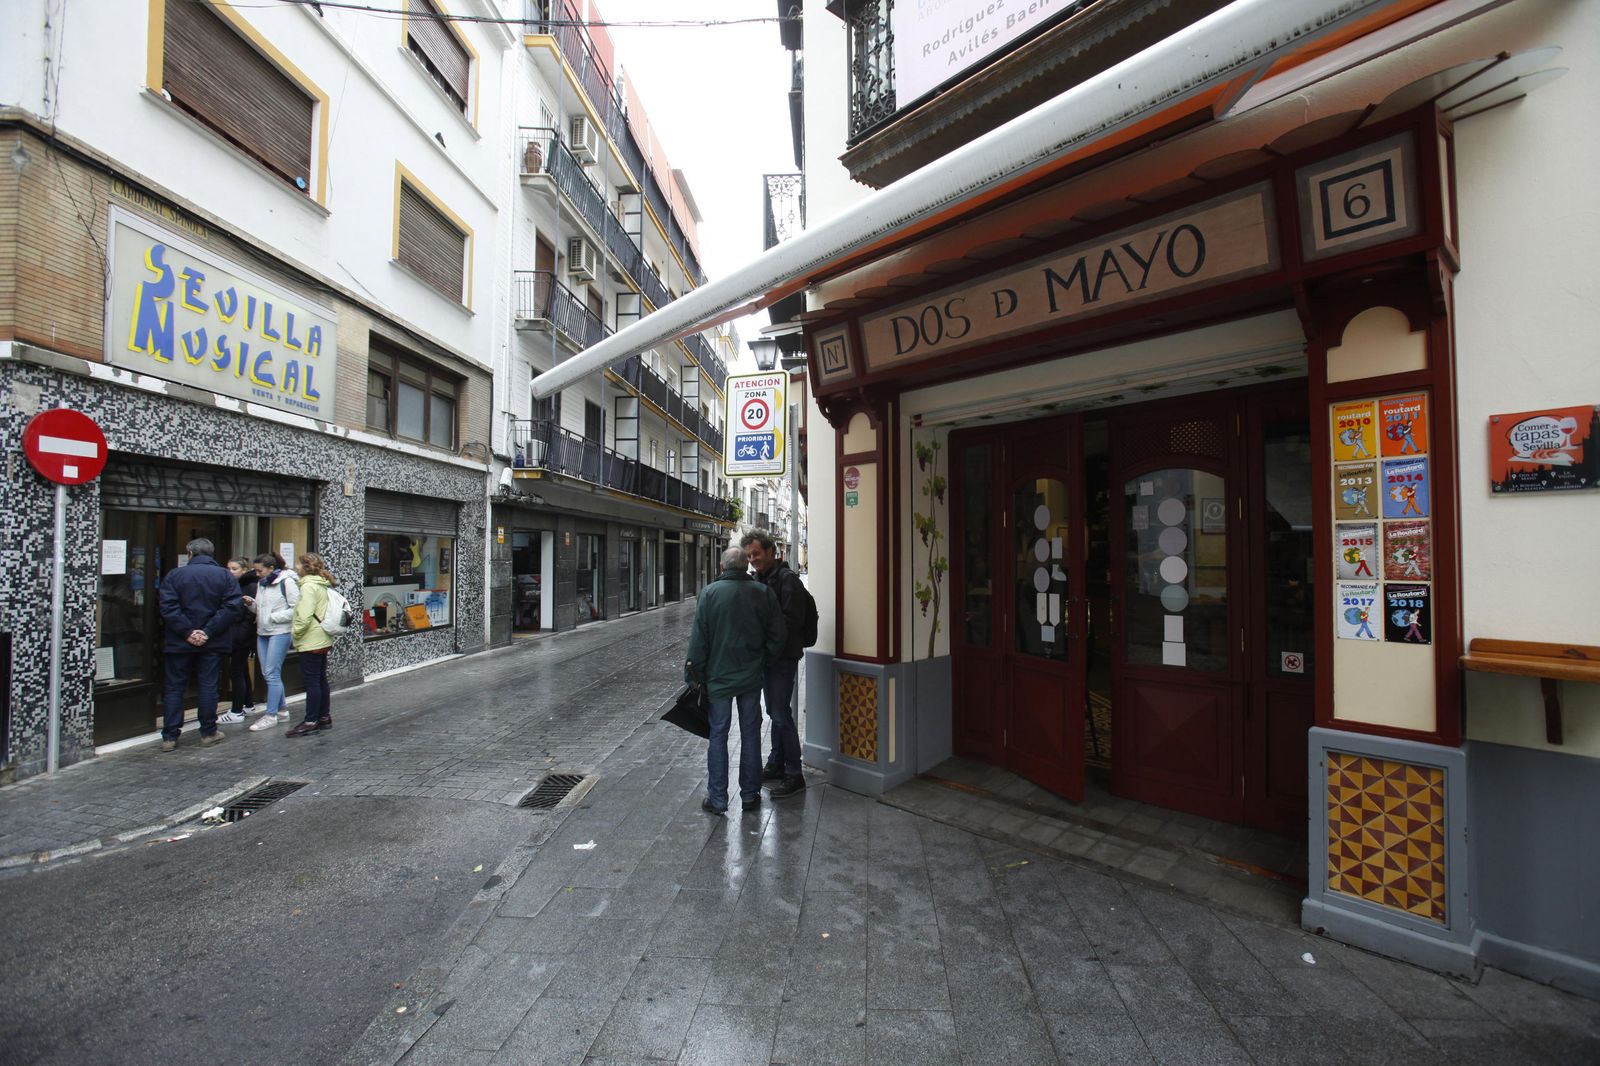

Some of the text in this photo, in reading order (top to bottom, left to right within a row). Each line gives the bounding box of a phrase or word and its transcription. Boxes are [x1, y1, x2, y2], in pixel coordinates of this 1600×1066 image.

[922, 0, 1005, 58] Rodríguez
[947, 26, 998, 66] Avilés
[1344, 183, 1371, 219] 6
[890, 297, 971, 356] DOS
[1041, 224, 1206, 315] MAYO
[144, 244, 322, 358] SEVILLA
[734, 378, 781, 389] ATENCION
[744, 390, 768, 399] ZONA
[747, 408, 764, 420] 20
[1383, 404, 1421, 415] routard
[1337, 411, 1371, 421] routard
[1386, 411, 1419, 422] 2011
[1339, 417, 1371, 428] 2010
[1517, 423, 1550, 432] Comer
[737, 435, 772, 443] PRIORIDAD
[1514, 429, 1560, 443] tapas
[1522, 441, 1560, 452] Sevilla
[1340, 476, 1373, 486] 2013
[1387, 473, 1424, 483] 2014
[1342, 538, 1373, 546] 2015
[1397, 590, 1426, 598] Routard
[1343, 597, 1375, 606] 2017
[1389, 599, 1424, 608] 2018
